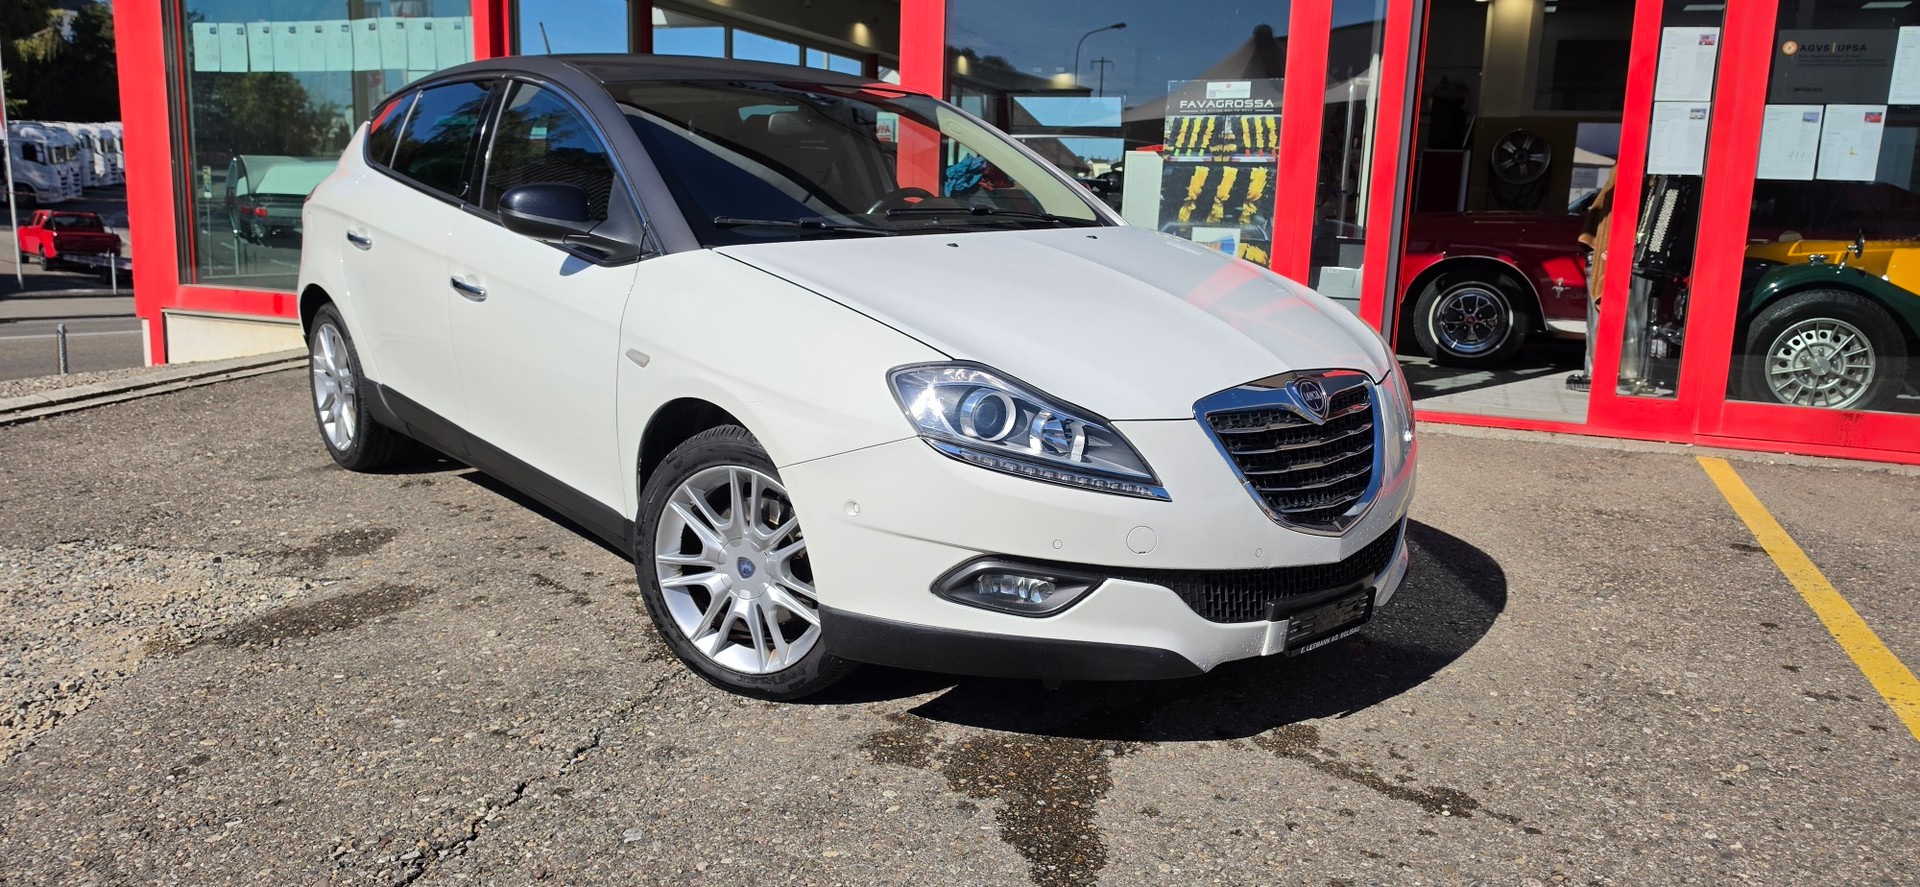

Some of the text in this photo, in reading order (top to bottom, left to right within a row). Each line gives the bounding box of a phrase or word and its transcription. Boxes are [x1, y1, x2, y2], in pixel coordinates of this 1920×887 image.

[1799, 43, 1867, 52] AGVS UPSA
[1179, 99, 1275, 109] FAVAGROSSA
[1306, 637, 1331, 651] LEEMANN
